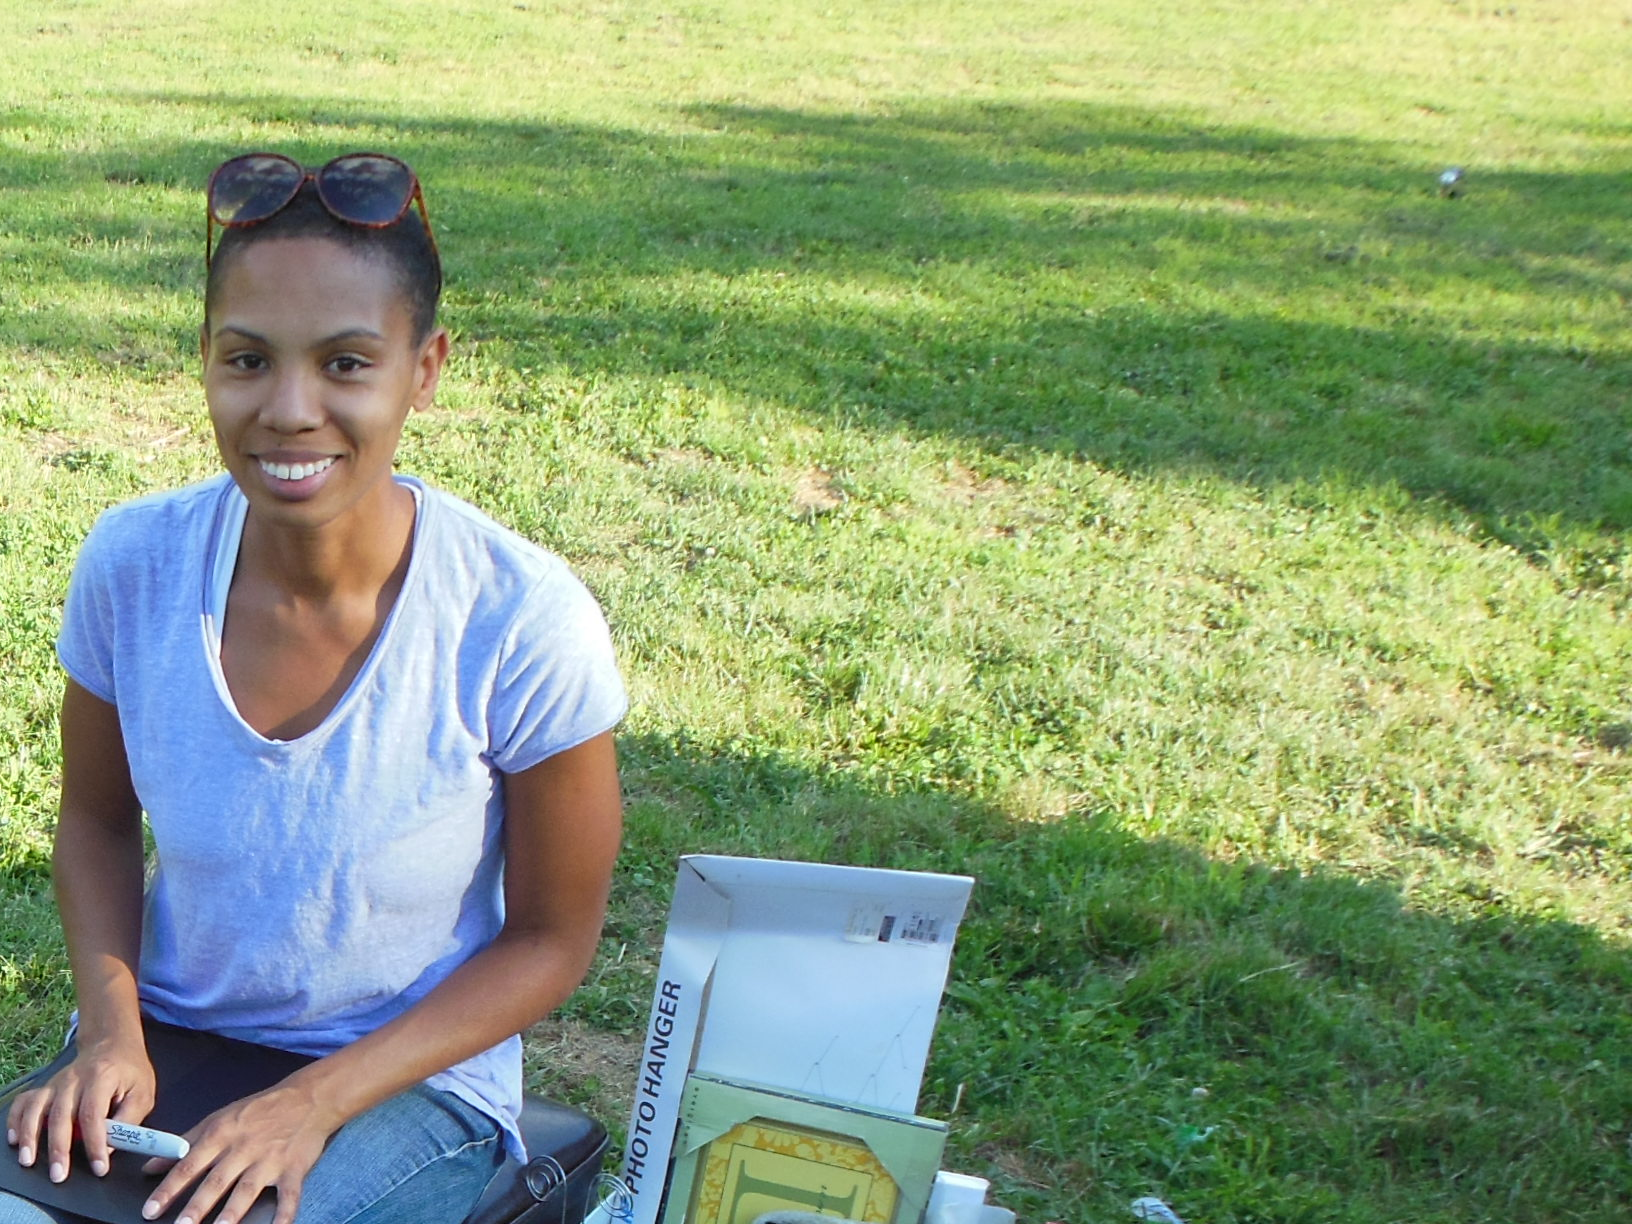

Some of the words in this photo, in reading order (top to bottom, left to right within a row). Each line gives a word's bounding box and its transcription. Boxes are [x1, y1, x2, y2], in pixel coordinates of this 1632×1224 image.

[107, 1125, 141, 1140] Sharpie
[625, 1101, 656, 1195] PHOTO
[642, 979, 681, 1098] HANGER
